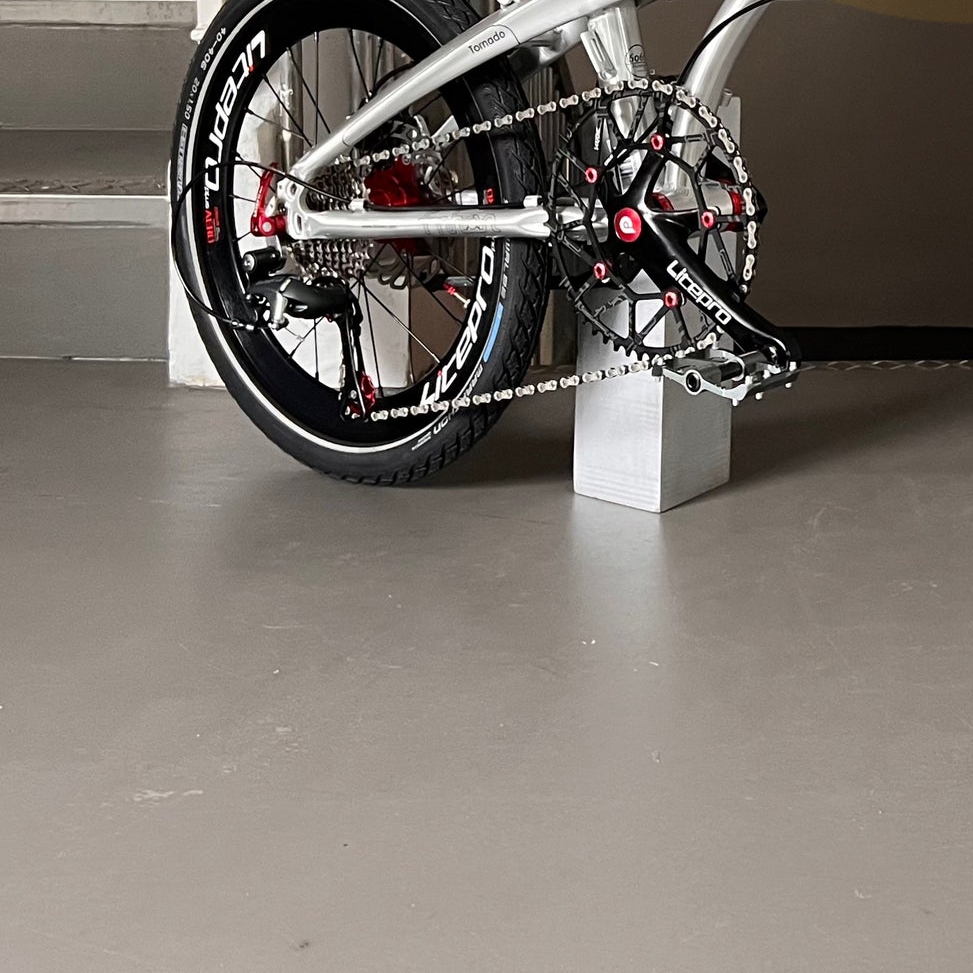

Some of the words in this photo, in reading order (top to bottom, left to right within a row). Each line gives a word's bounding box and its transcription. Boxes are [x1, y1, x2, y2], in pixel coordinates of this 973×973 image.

[468, 30, 506, 55] Tornado
[204, 29, 266, 192] Litepro
[420, 244, 494, 406] Litepro
[666, 259, 733, 326] Litepro
